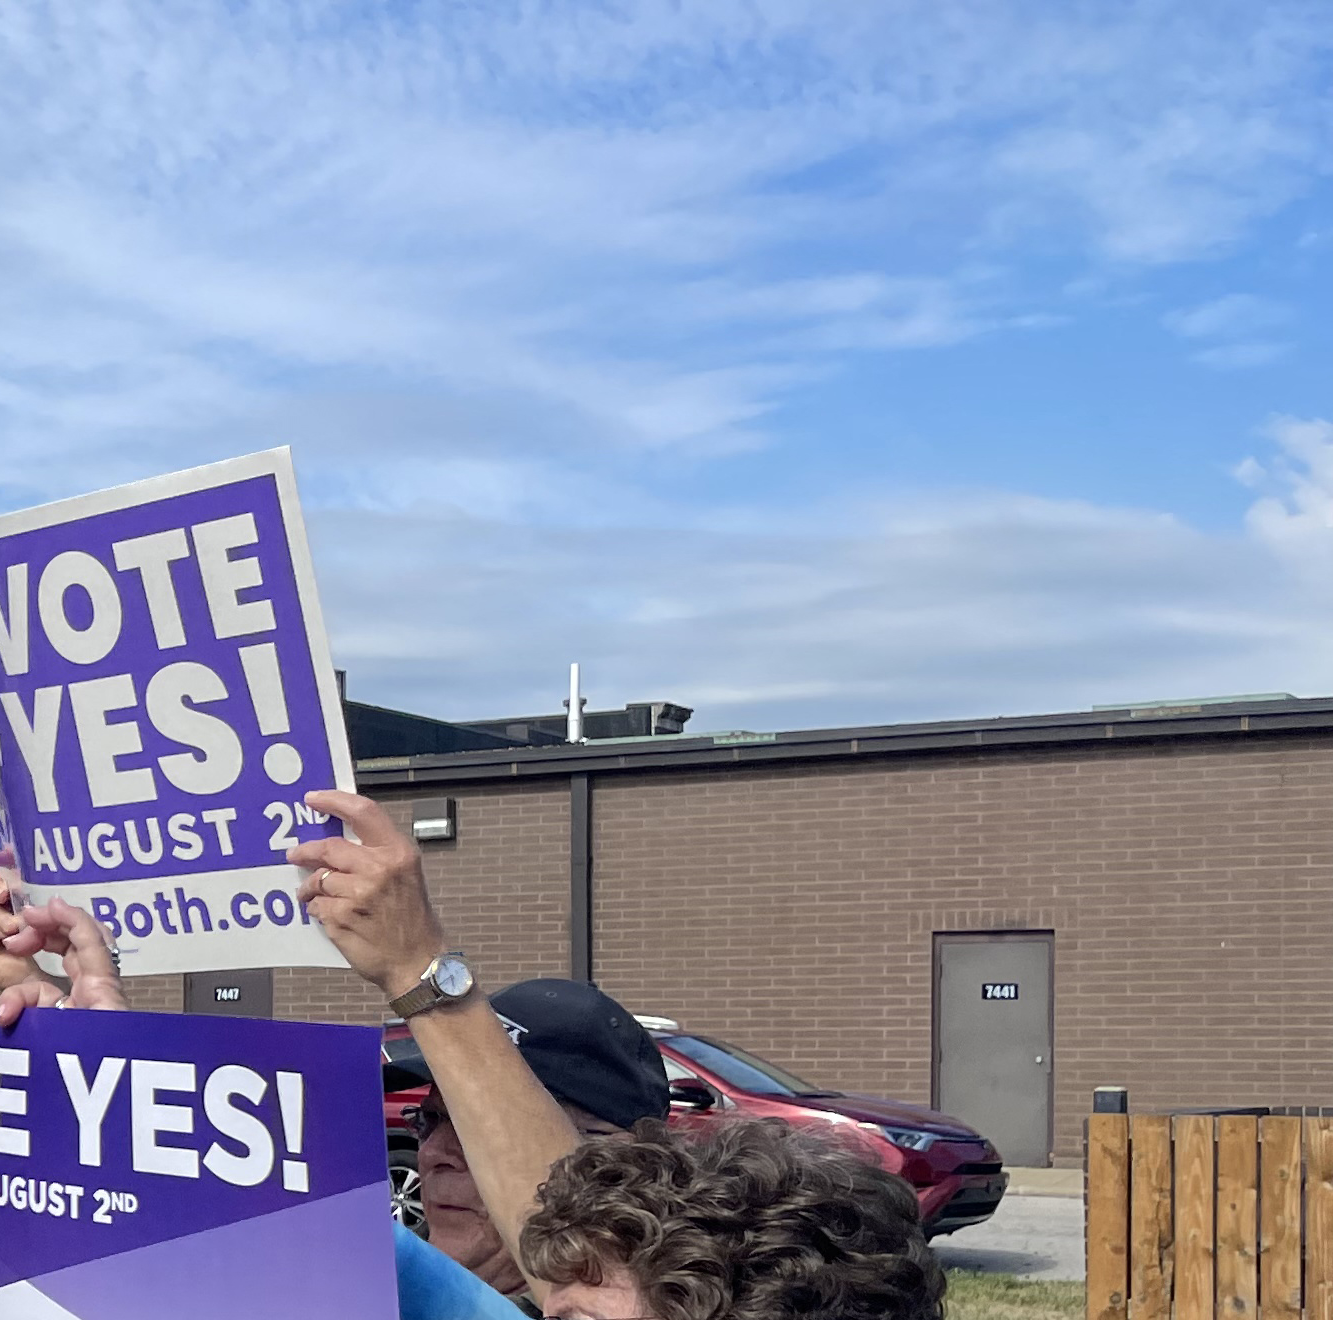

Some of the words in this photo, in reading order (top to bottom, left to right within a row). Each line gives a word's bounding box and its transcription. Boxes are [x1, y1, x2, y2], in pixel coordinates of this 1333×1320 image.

[34, 807, 237, 874] AUGUST
[215, 988, 239, 1001] 7447
[985, 985, 1015, 998] 7441
[56, 1053, 311, 1193] YES!
[91, 1189, 139, 1226] 2ND
